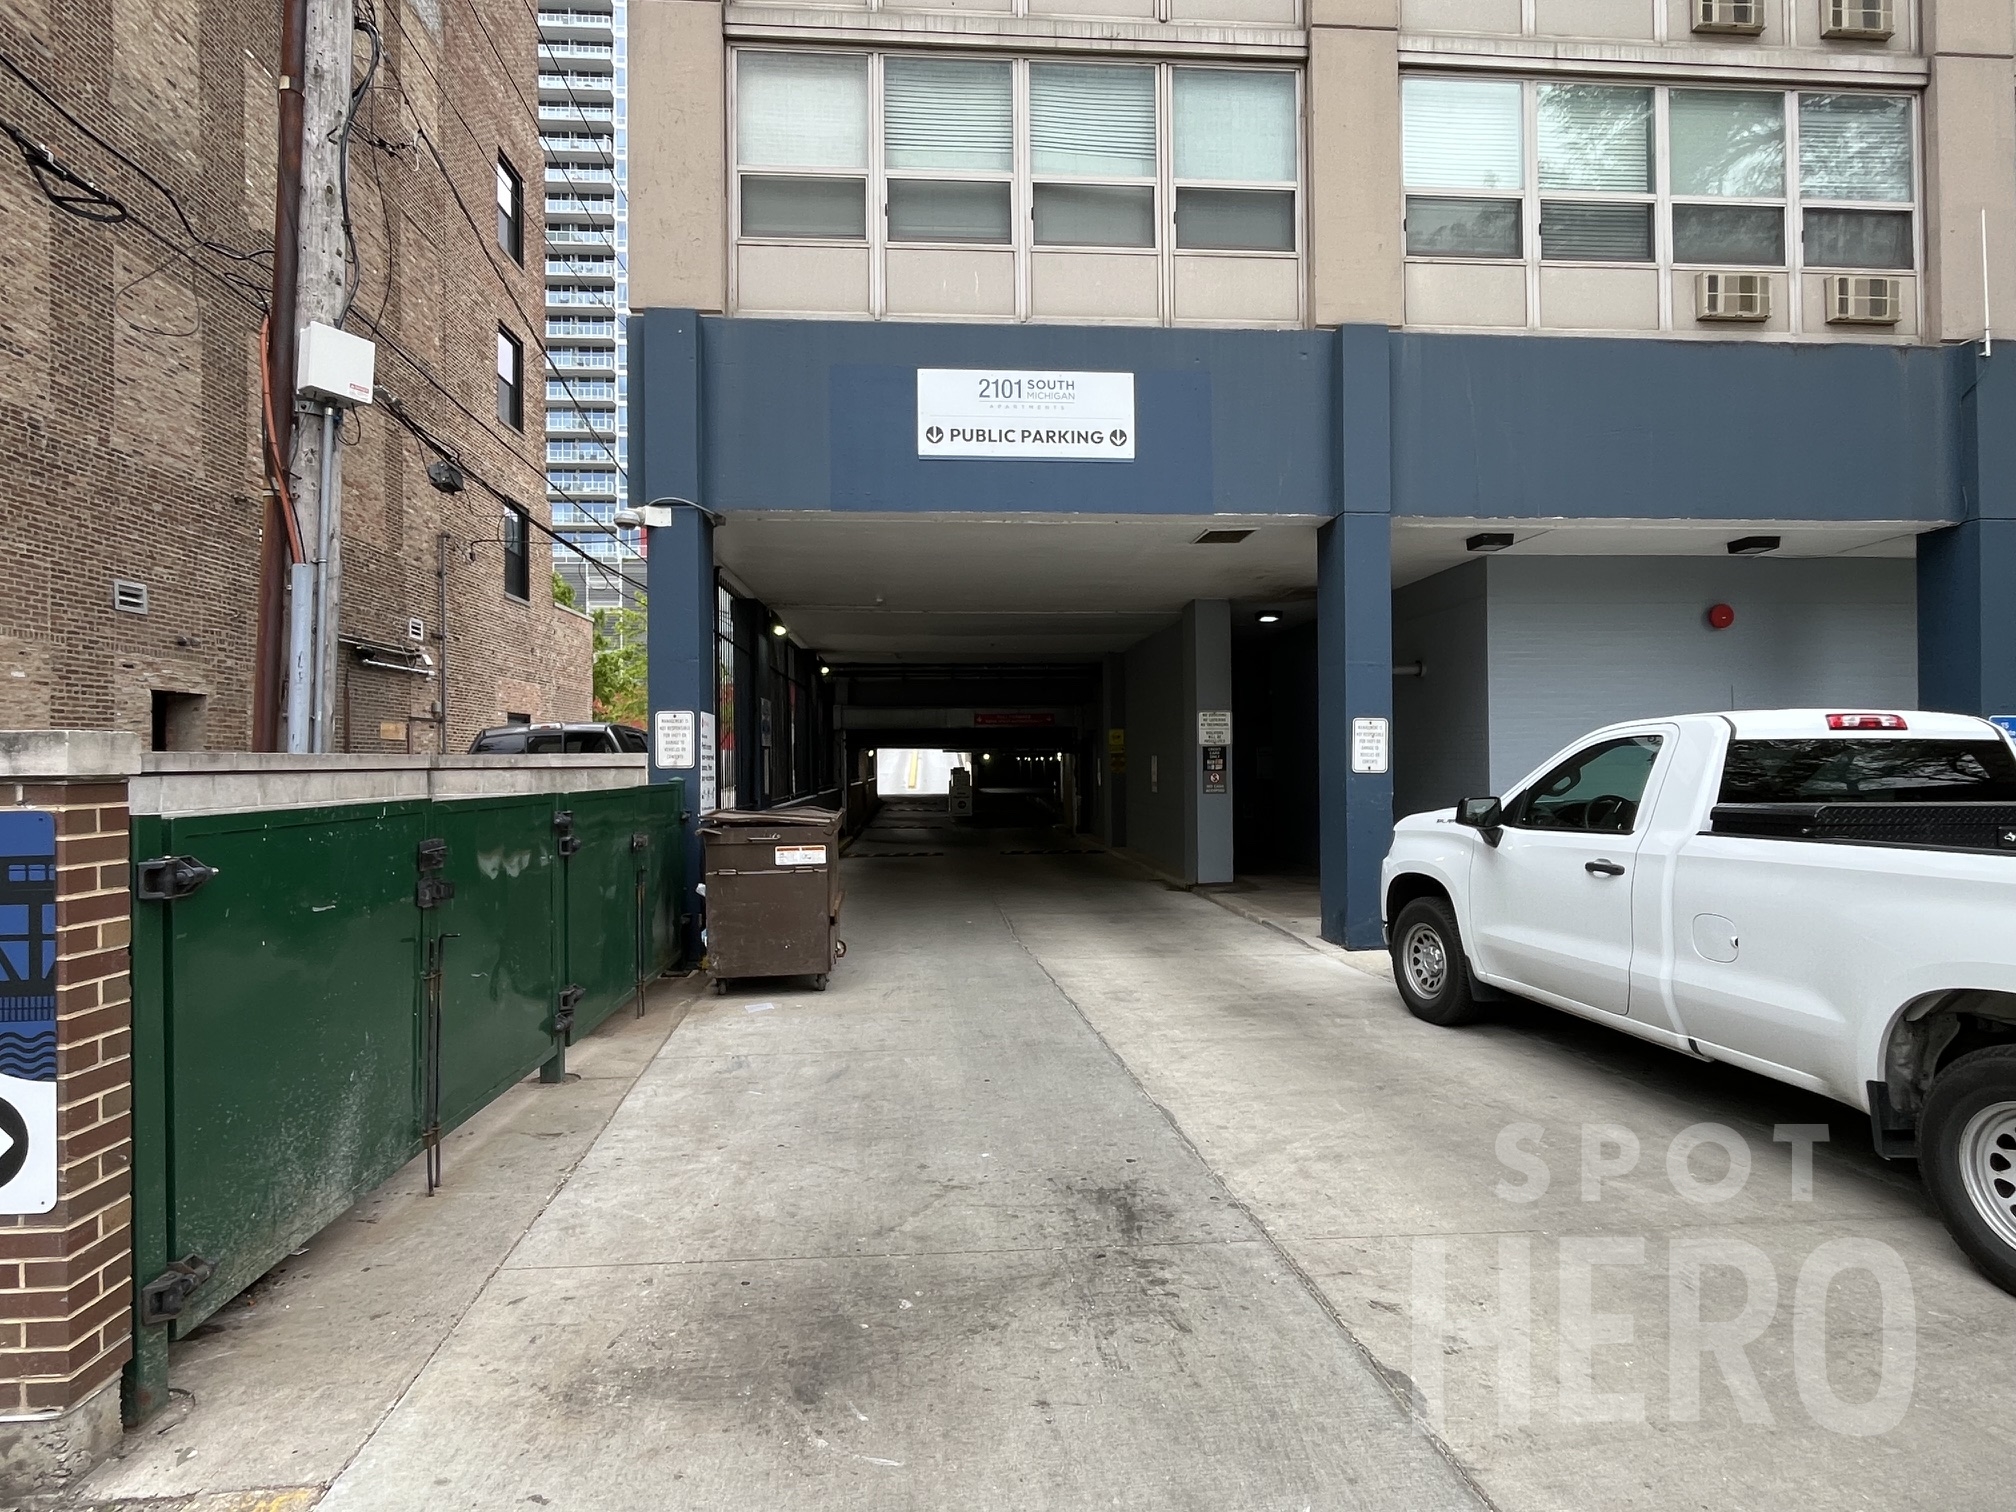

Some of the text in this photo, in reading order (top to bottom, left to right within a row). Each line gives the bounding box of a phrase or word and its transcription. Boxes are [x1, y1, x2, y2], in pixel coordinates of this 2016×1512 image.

[978, 378, 1075, 399] 2101 SOUTH
[1026, 391, 1075, 400] MICHIGAN
[950, 428, 1104, 444] PUBLIC PARKING
